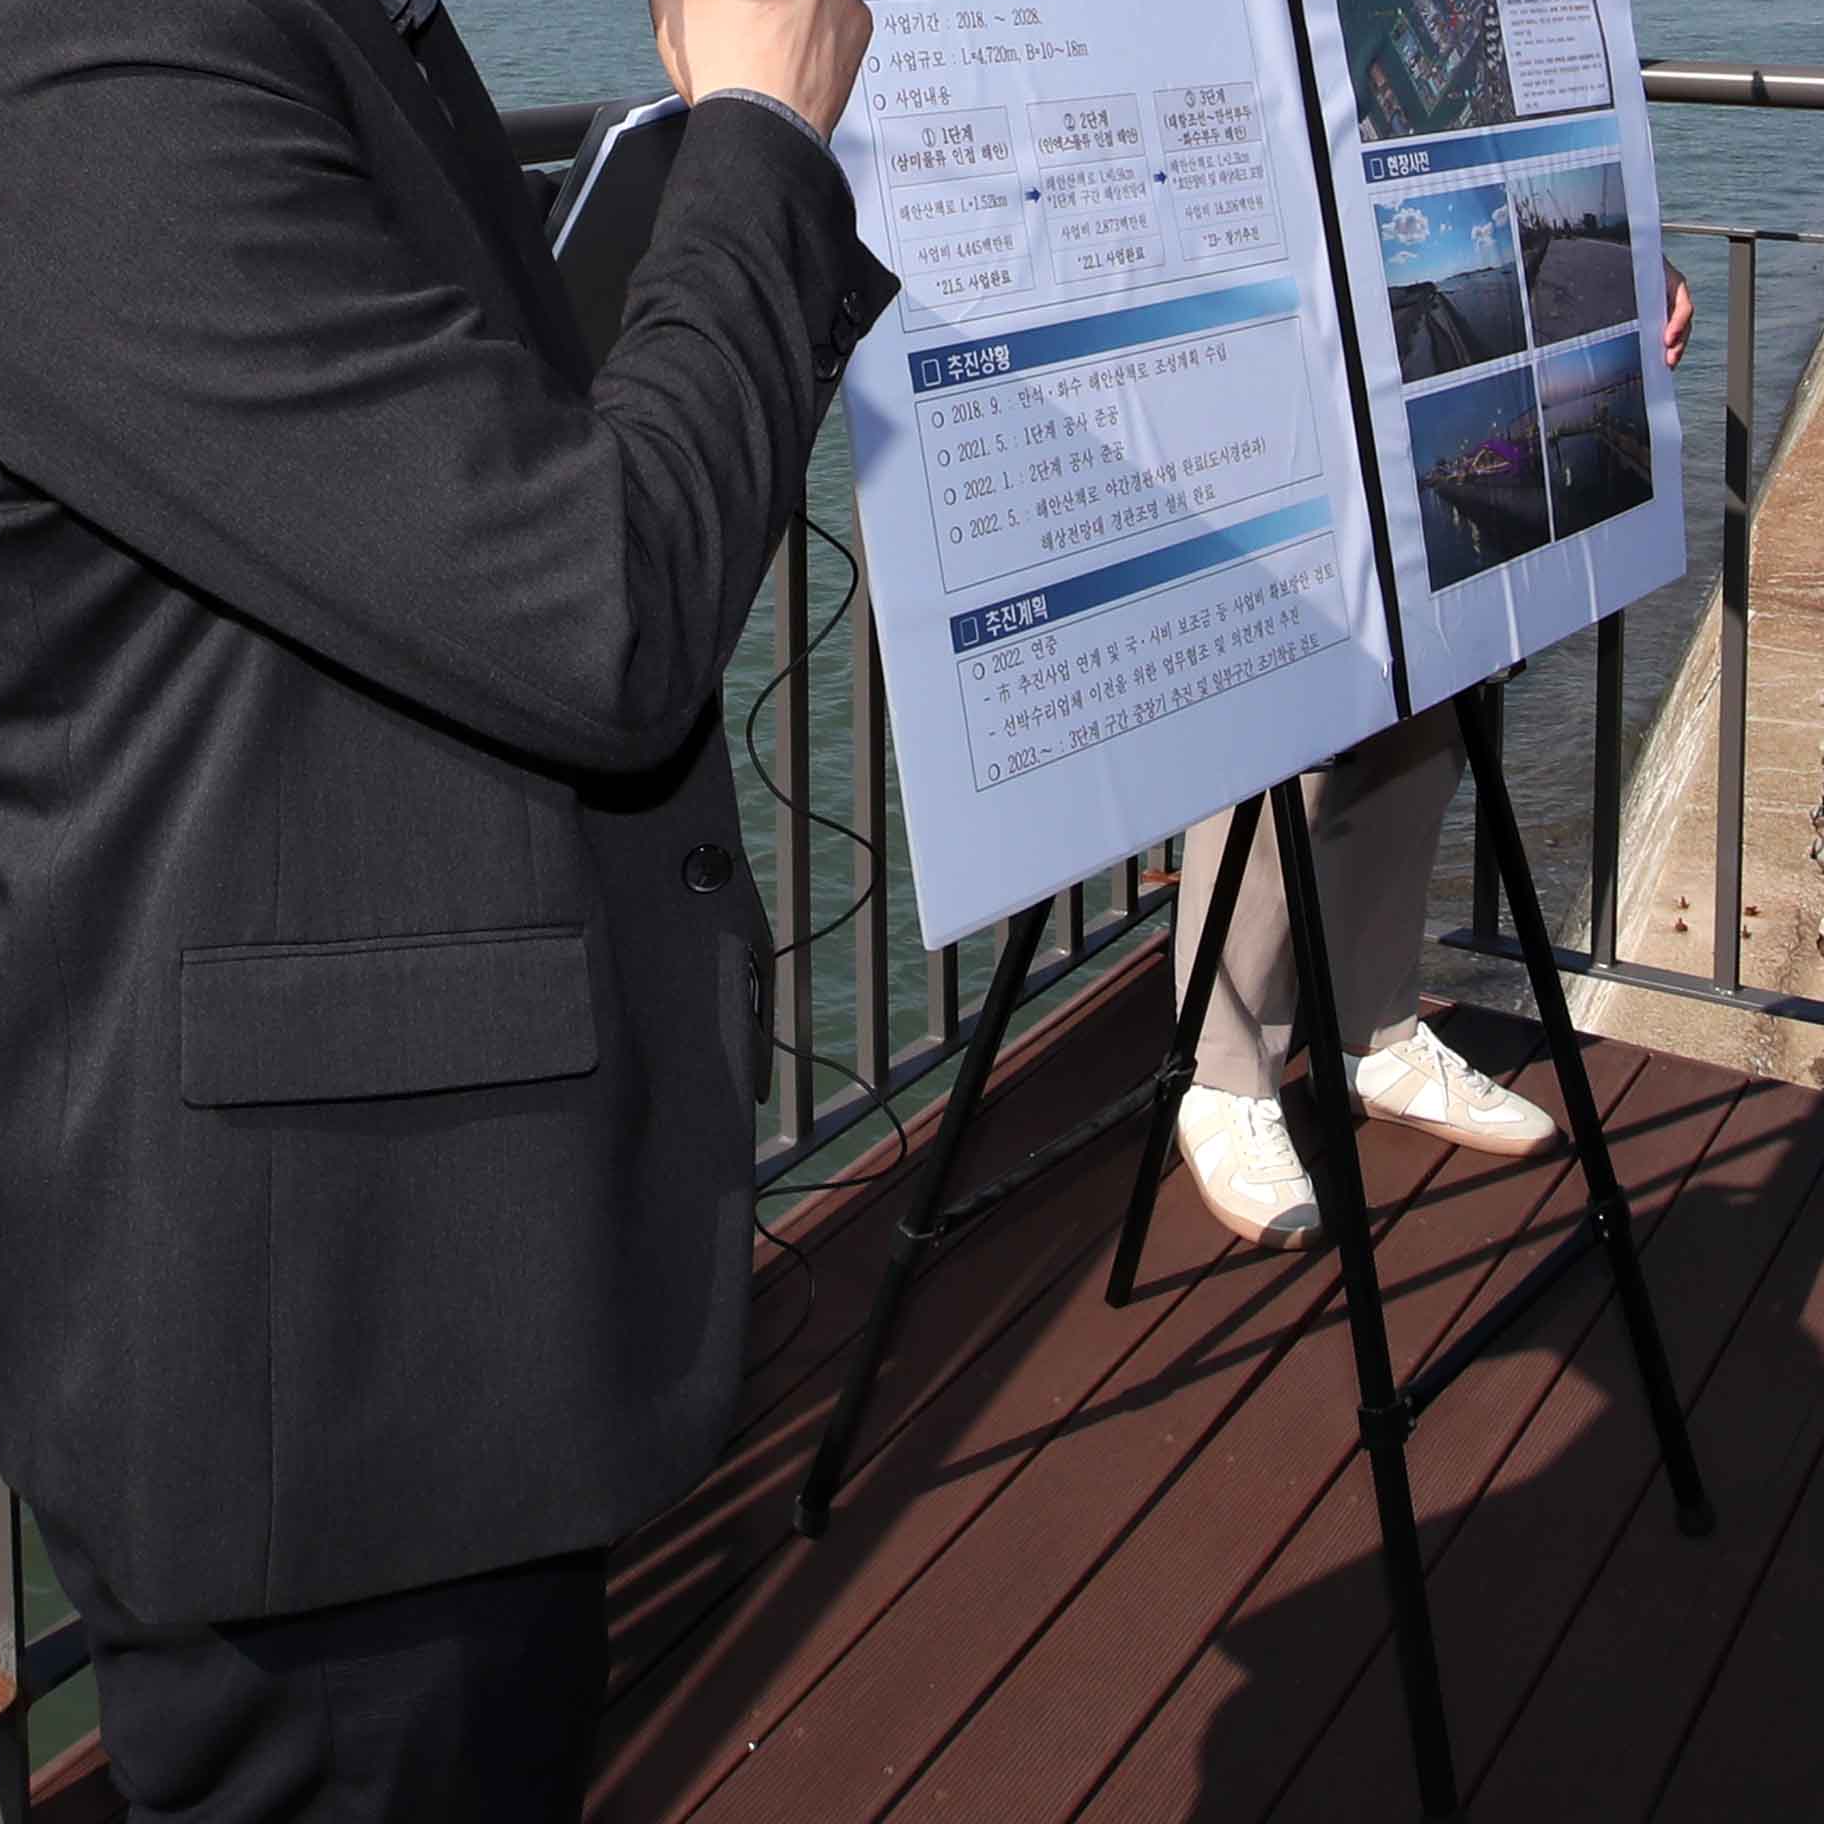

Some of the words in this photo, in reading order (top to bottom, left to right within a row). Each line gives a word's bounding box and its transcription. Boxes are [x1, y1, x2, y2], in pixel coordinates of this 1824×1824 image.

[884, 12, 940, 34] 사업기간
[889, 51, 946, 73] 사업규모
[895, 86, 951, 110] 사업내용
[1387, 151, 1431, 177] 현장사진
[947, 344, 1010, 380] 추진상황
[952, 400, 984, 424] 2018.
[1089, 362, 1151, 392] 해안산책로
[958, 437, 991, 462] 2021.
[1024, 419, 1057, 446] 1단계
[1063, 412, 1089, 437] 공사
[1095, 404, 1119, 428] 준공
[963, 475, 997, 500] 2022.
[1029, 456, 1062, 482] 2단계
[1069, 448, 1094, 472] 공사
[1101, 441, 1125, 463] 준공
[970, 513, 1002, 539] 2022.
[1036, 486, 1101, 518] 해안산책로
[985, 594, 1048, 637] 추진계획
[992, 648, 1025, 674] 2022.
[1031, 635, 1057, 661] 연중
[1018, 660, 1071, 695] 추진사업
[1076, 647, 1101, 674] 연계
[1107, 642, 1120, 665] 및
[1178, 608, 1211, 636] 보조금
[1233, 588, 1265, 615] 사업비
[1004, 689, 1083, 738] 선박수리업체
[1089, 674, 1128, 703] 이전을
[1134, 662, 1157, 687] 위한
[1162, 643, 1211, 676] 업무협조
[1279, 606, 1301, 629] 추진
[1104, 709, 1129, 735] 구간
[1134, 694, 1167, 724] 중장기
[1171, 682, 1194, 708] 추진
